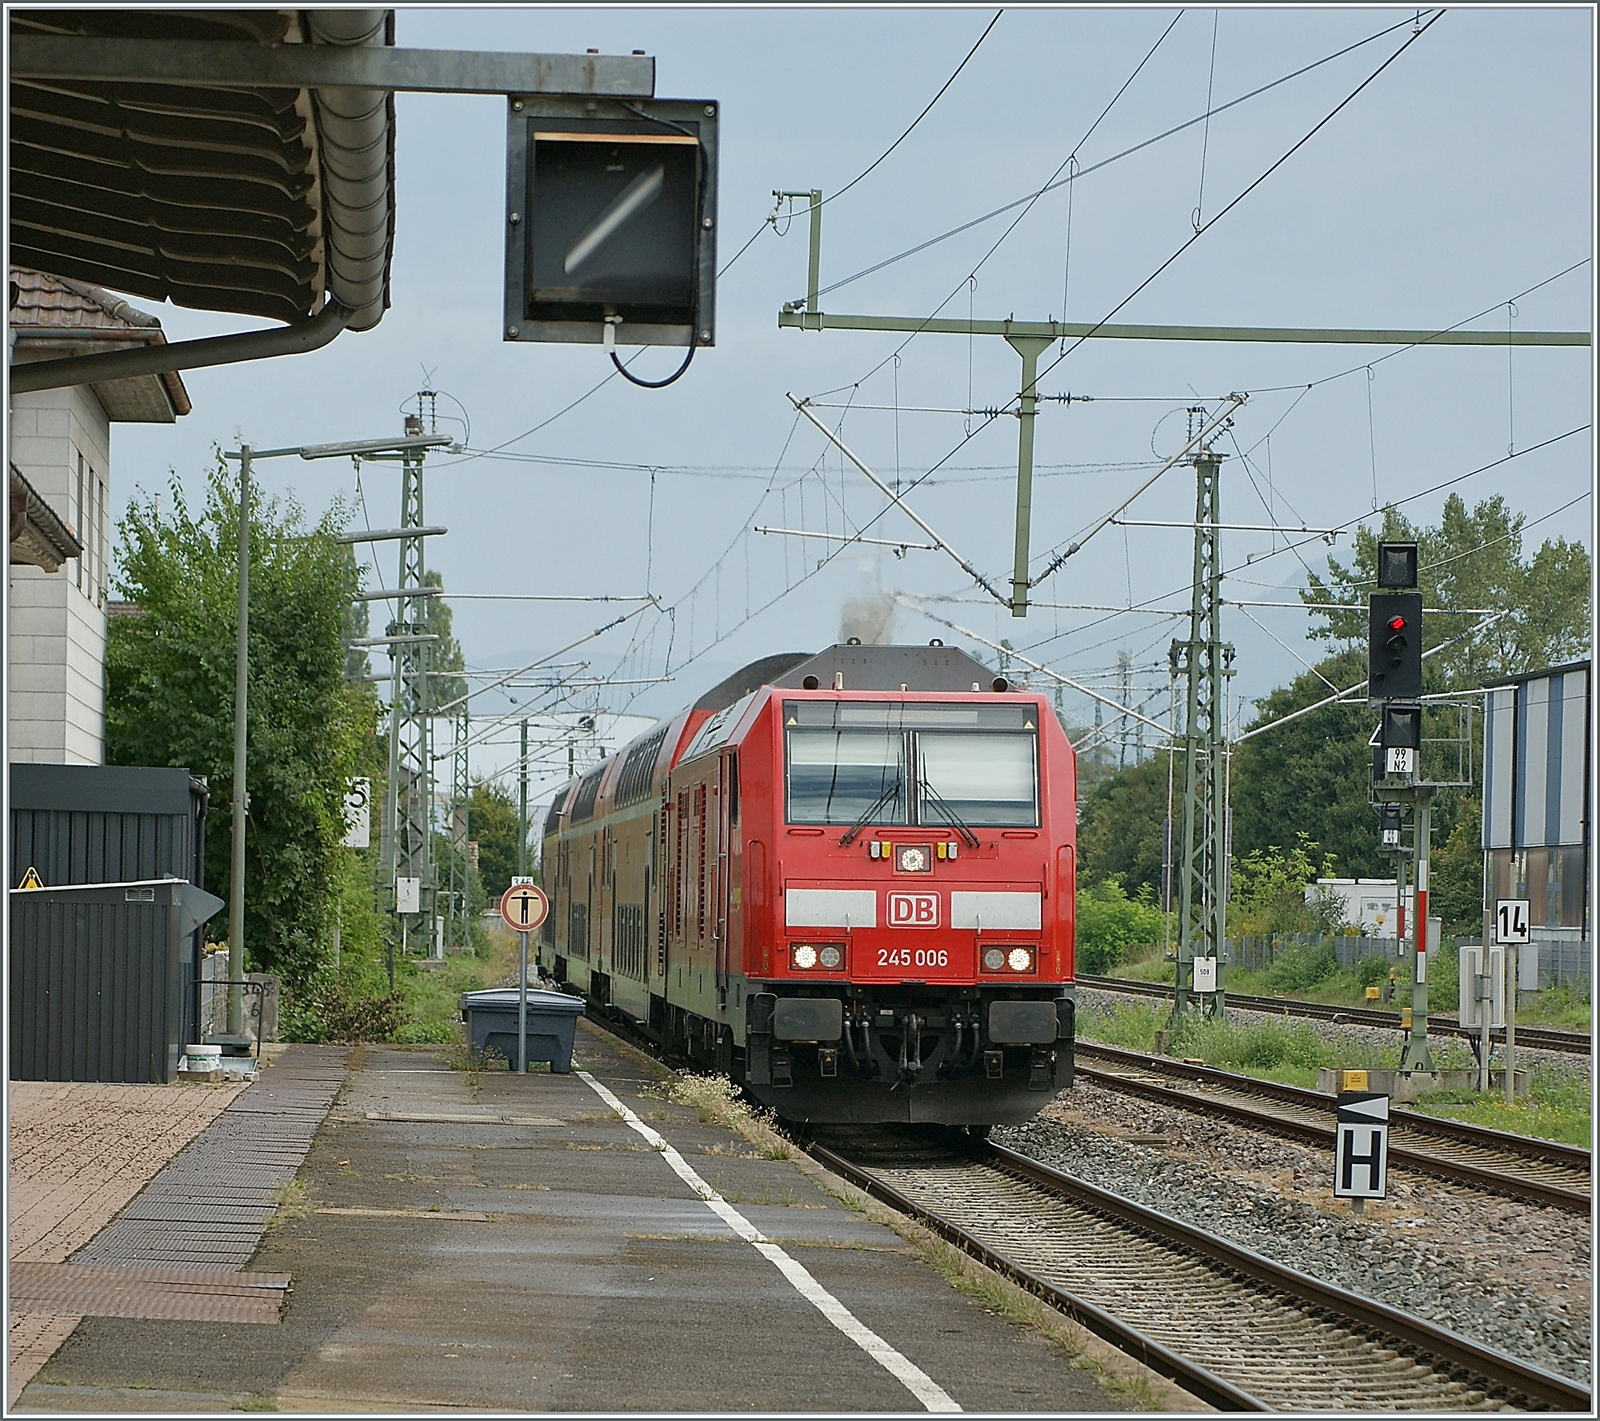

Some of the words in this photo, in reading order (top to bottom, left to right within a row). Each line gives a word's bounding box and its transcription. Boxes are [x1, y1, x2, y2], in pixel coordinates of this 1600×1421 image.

[1394, 748, 1407, 760] 99
[1393, 760, 1407, 772] N2
[894, 897, 934, 922] DB
[1499, 905, 1527, 938] 14
[877, 949, 911, 966] 245
[915, 949, 948, 967] 006
[1341, 1129, 1381, 1191] H
